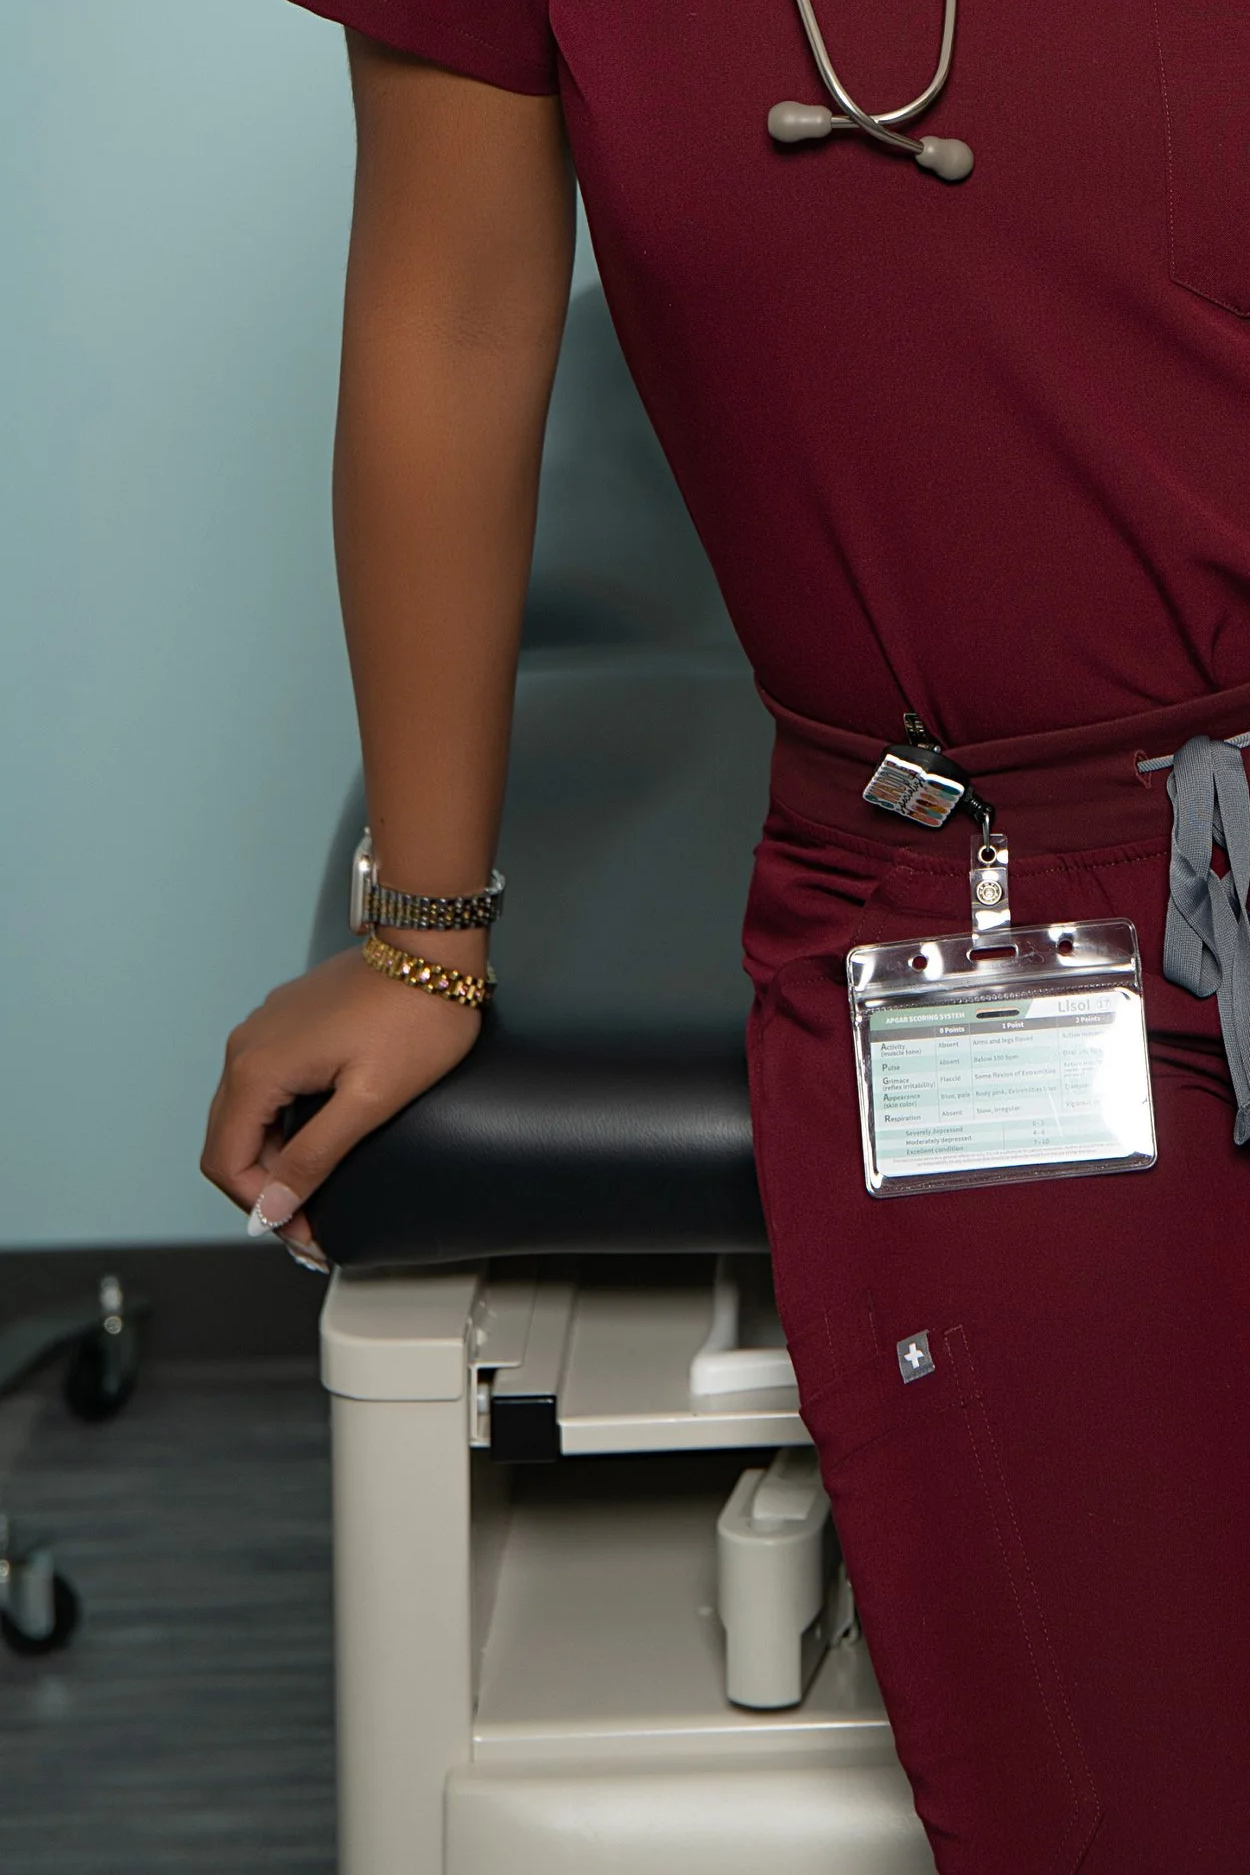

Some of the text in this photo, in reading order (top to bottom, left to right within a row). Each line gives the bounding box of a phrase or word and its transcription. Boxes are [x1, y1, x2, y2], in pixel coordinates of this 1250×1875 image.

[885, 1012, 965, 1024] APGAR SCORING SYSTEM
[880, 1043, 905, 1051] Activity
[882, 1077, 909, 1085] Grimace
[883, 1093, 921, 1102] Appearance
[884, 1114, 921, 1123] Respiration
[905, 1126, 963, 1137] Severely depressed
[906, 1135, 972, 1146] Moderately depressed
[906, 1148, 934, 1156] Excellent
